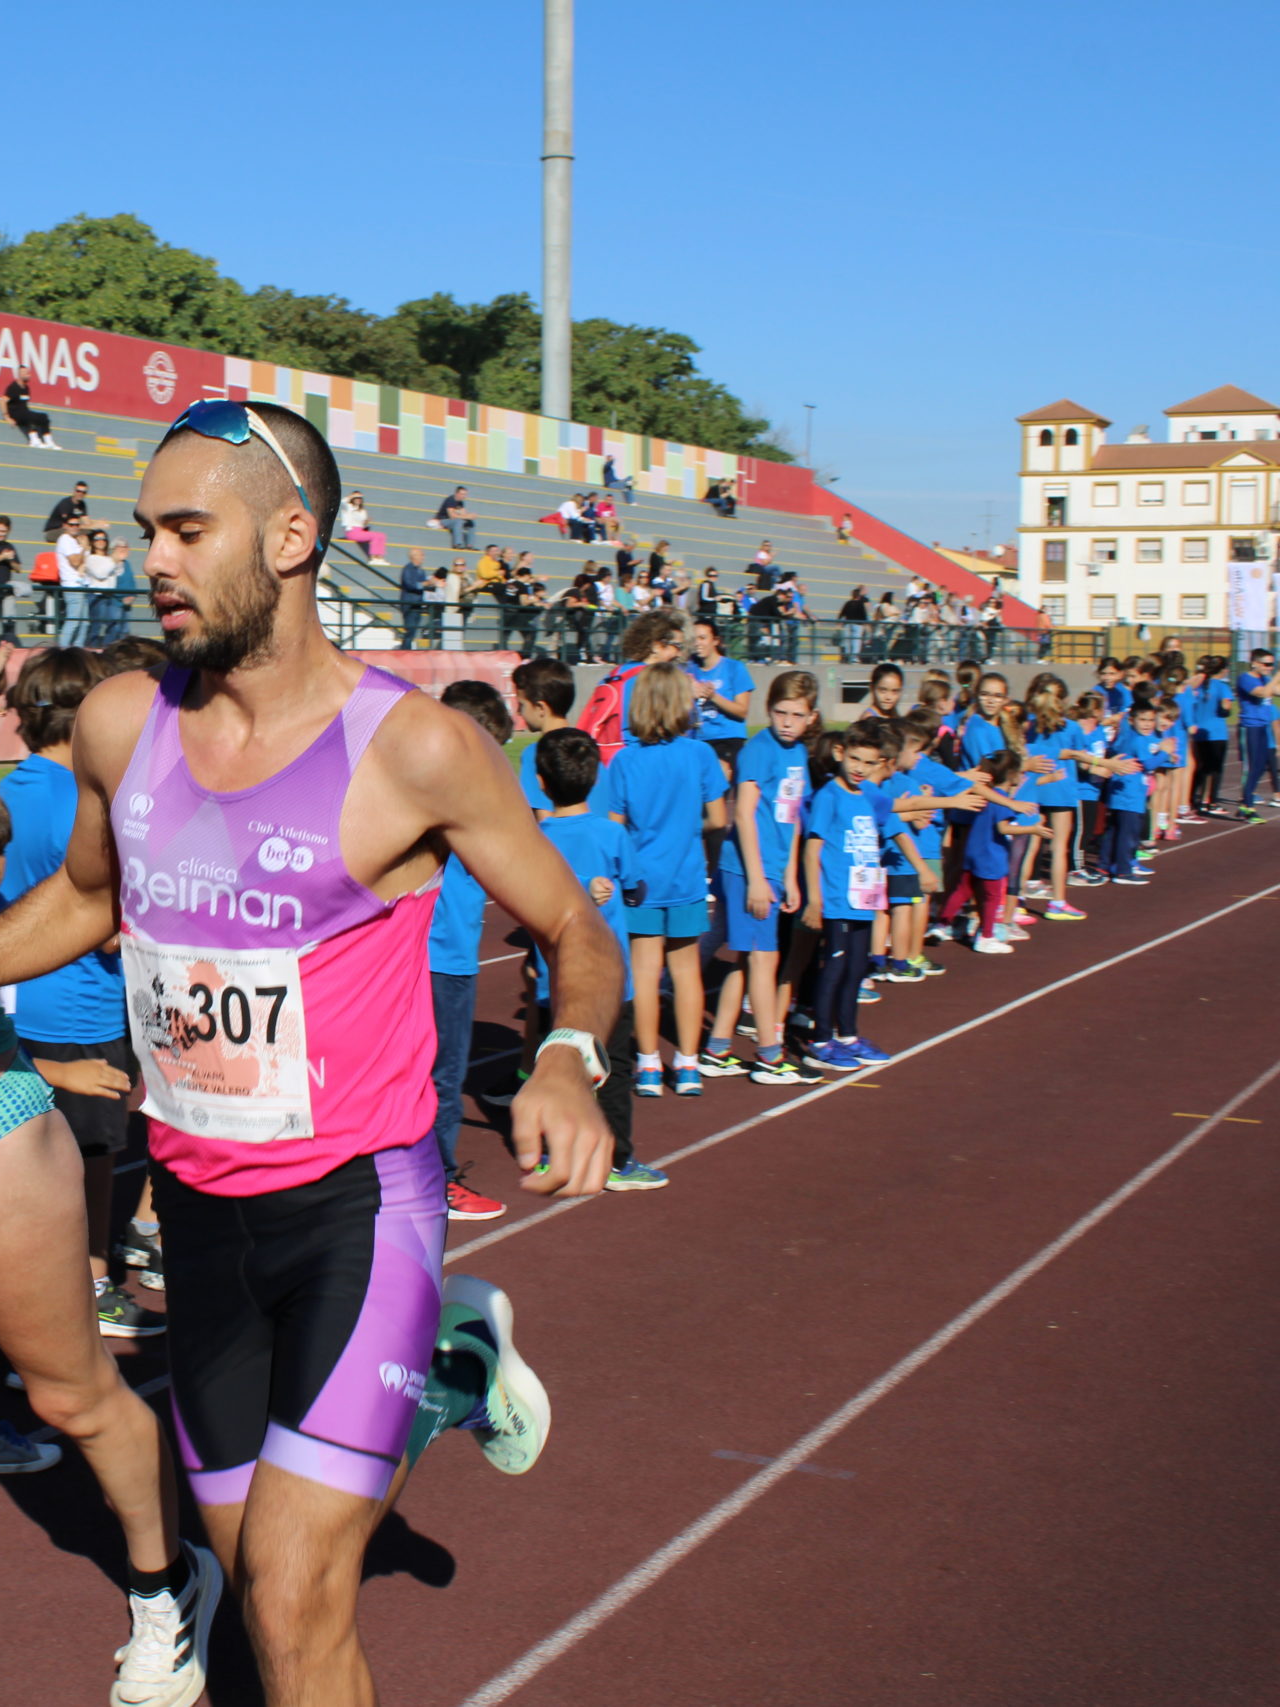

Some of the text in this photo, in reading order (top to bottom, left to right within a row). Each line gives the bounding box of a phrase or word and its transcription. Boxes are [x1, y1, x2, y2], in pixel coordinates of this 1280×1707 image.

[247, 820, 329, 845] Club Atletismo
[177, 857, 238, 883] clínica
[188, 983, 288, 1044] 307
